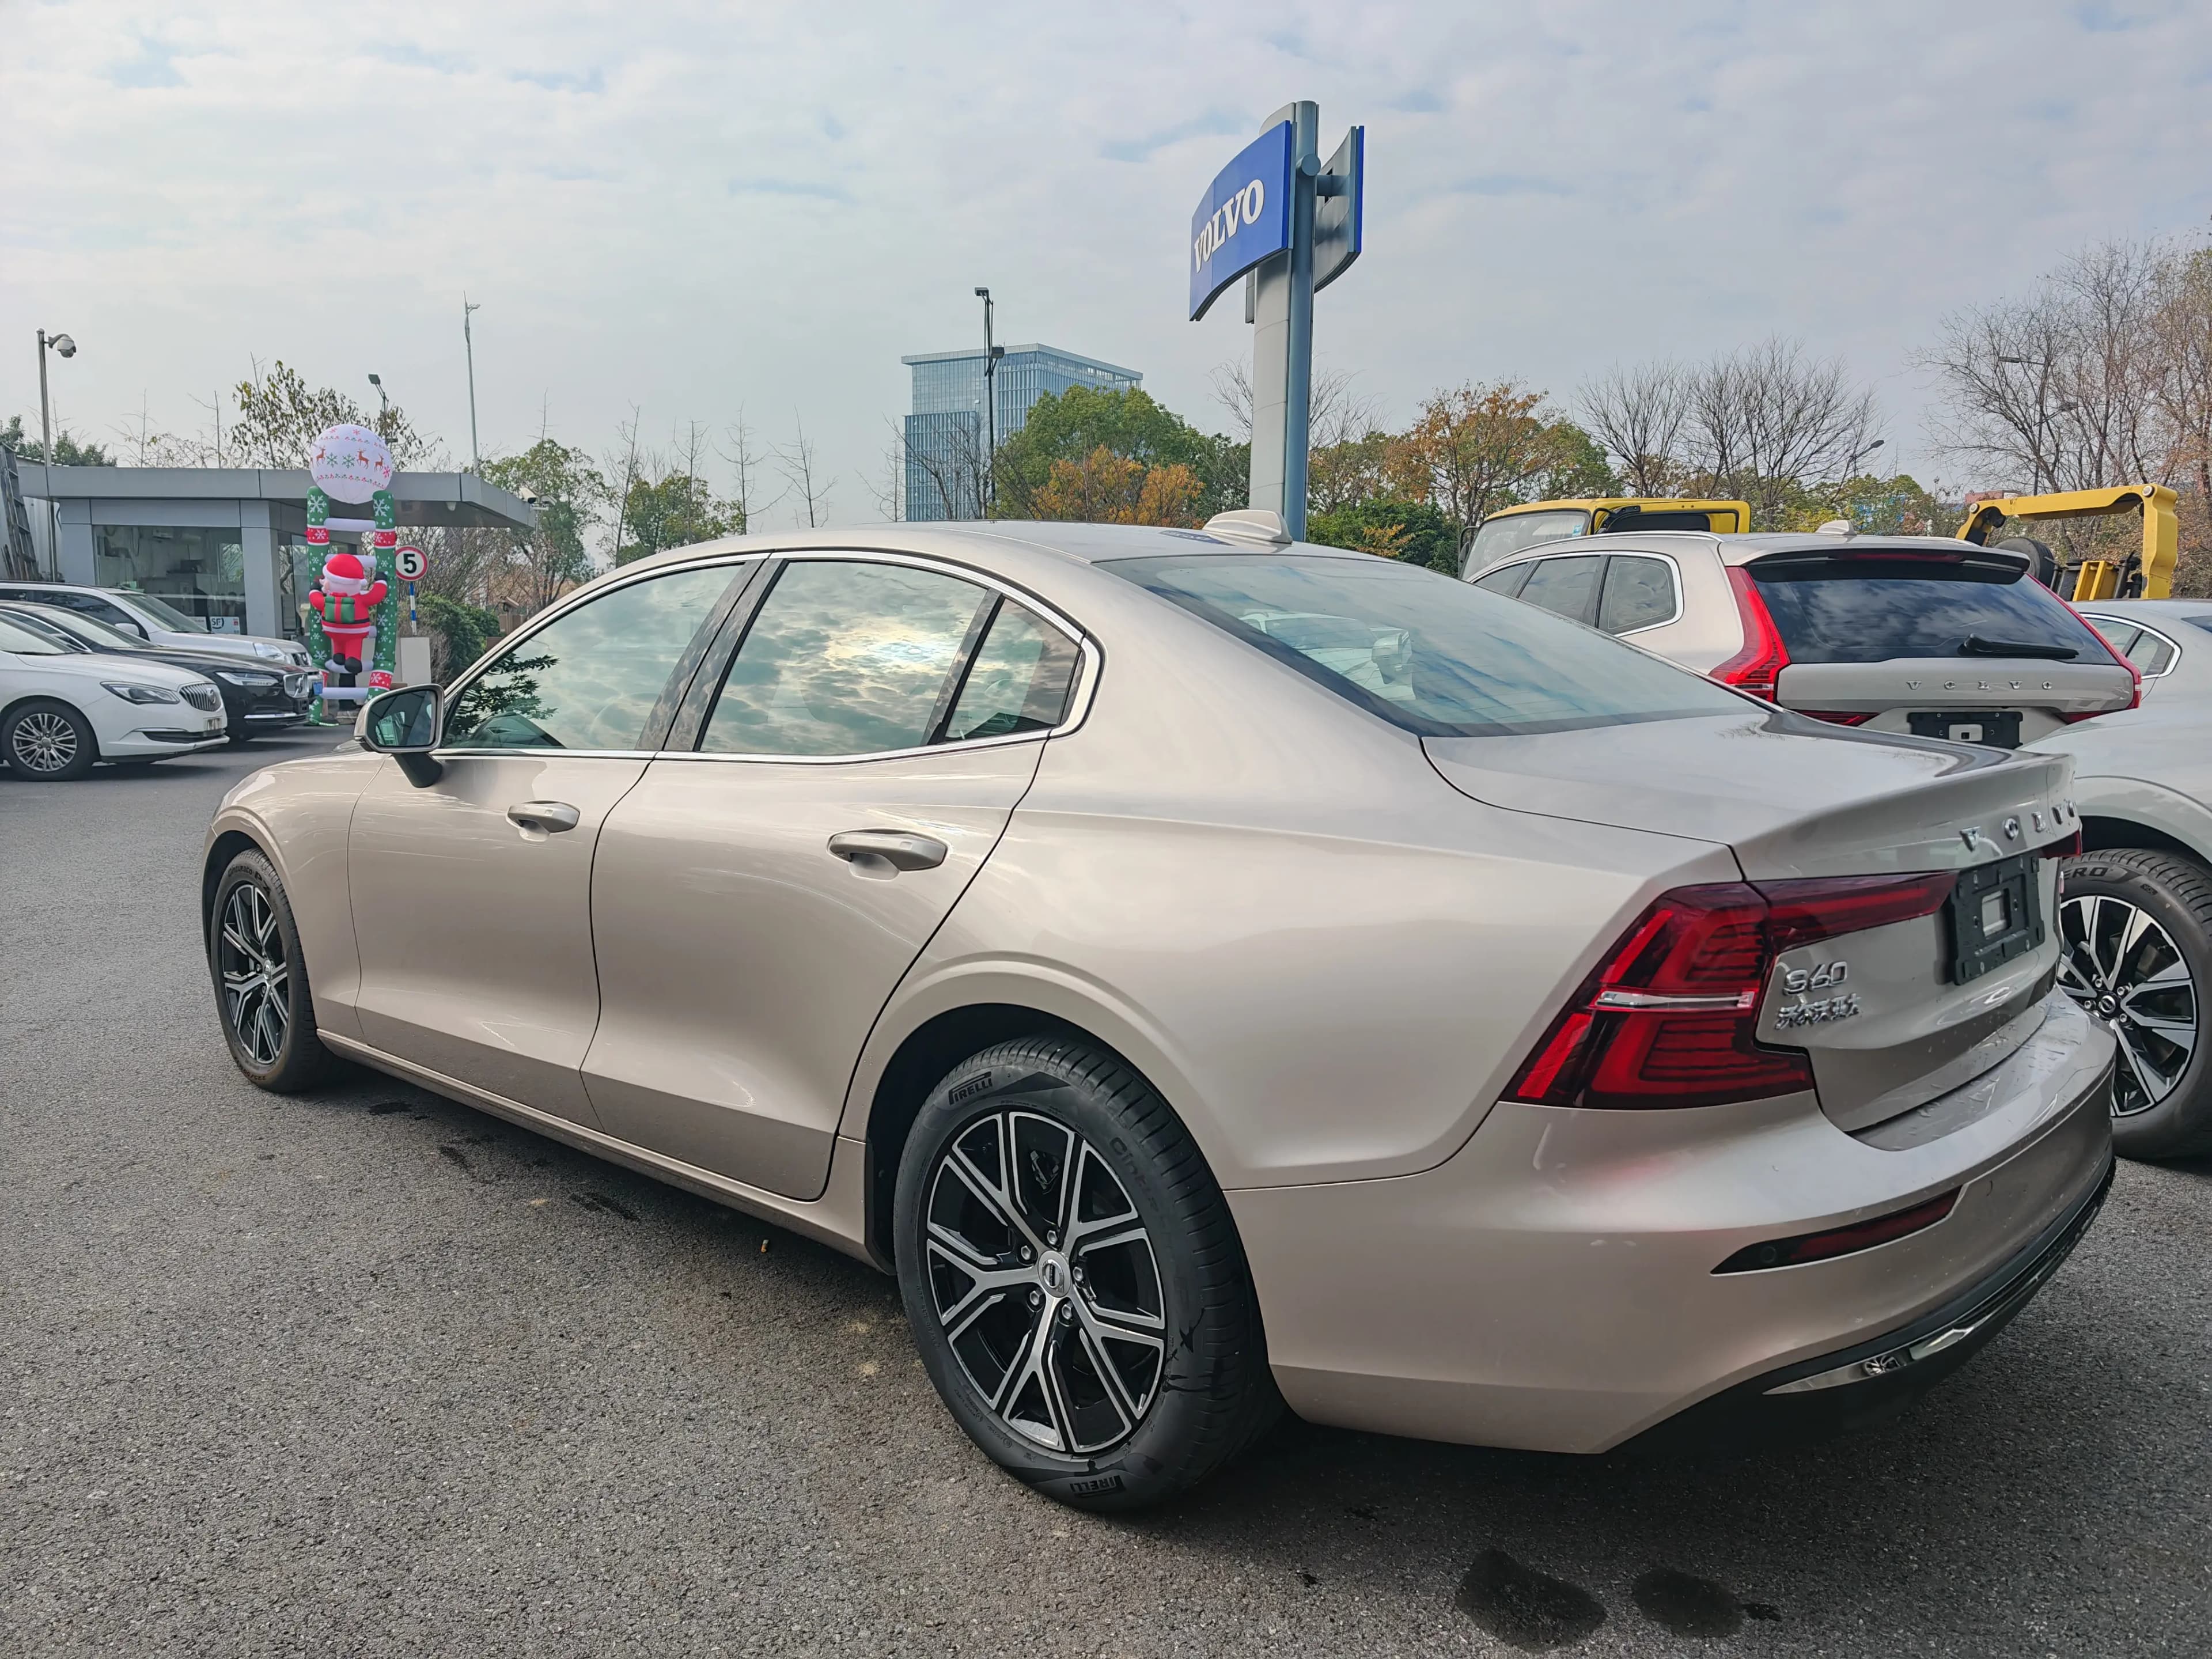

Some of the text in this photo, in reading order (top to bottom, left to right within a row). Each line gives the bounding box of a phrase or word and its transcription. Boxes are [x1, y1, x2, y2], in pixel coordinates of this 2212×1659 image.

[1194, 179, 1264, 274] VOLVO
[403, 553, 417, 574] 5
[1783, 961, 1847, 996] S60
[948, 1071, 993, 1106] PIRELLI
[1069, 1475, 1126, 1497] PIRELLI
